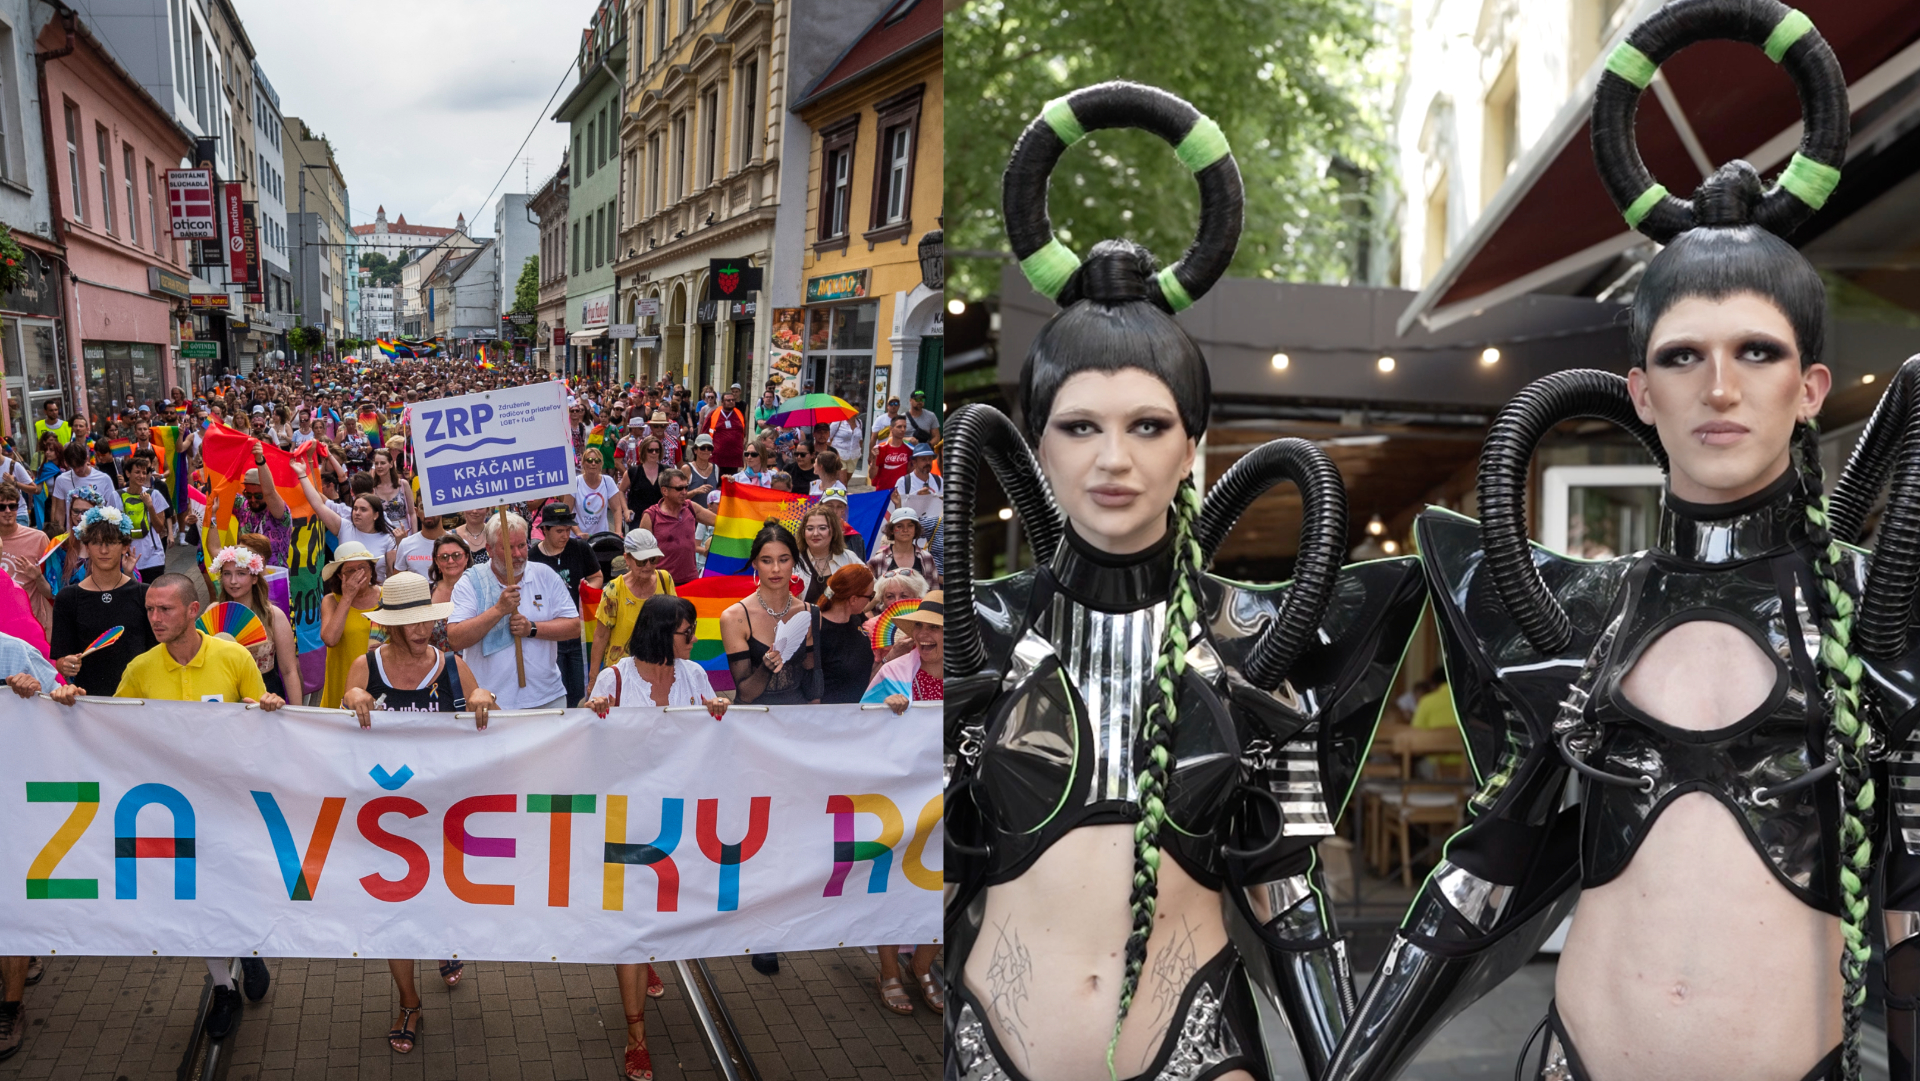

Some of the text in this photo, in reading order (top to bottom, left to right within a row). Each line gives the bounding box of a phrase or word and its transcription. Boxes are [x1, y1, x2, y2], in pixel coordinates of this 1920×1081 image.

[173, 218, 213, 230] oticon
[230, 195, 239, 234] martinus
[817, 275, 855, 296] AVOKADO
[498, 400, 531, 411] Združenie
[499, 409, 524, 419] rodičov
[531, 404, 561, 416] priateľov
[421, 403, 494, 442] ZRP
[454, 456, 536, 481] KRÁČAME
[435, 469, 564, 501] S NAŠIMI DEŤMI
[26, 781, 197, 900] ZA
[249, 763, 772, 913] VŠETKY
